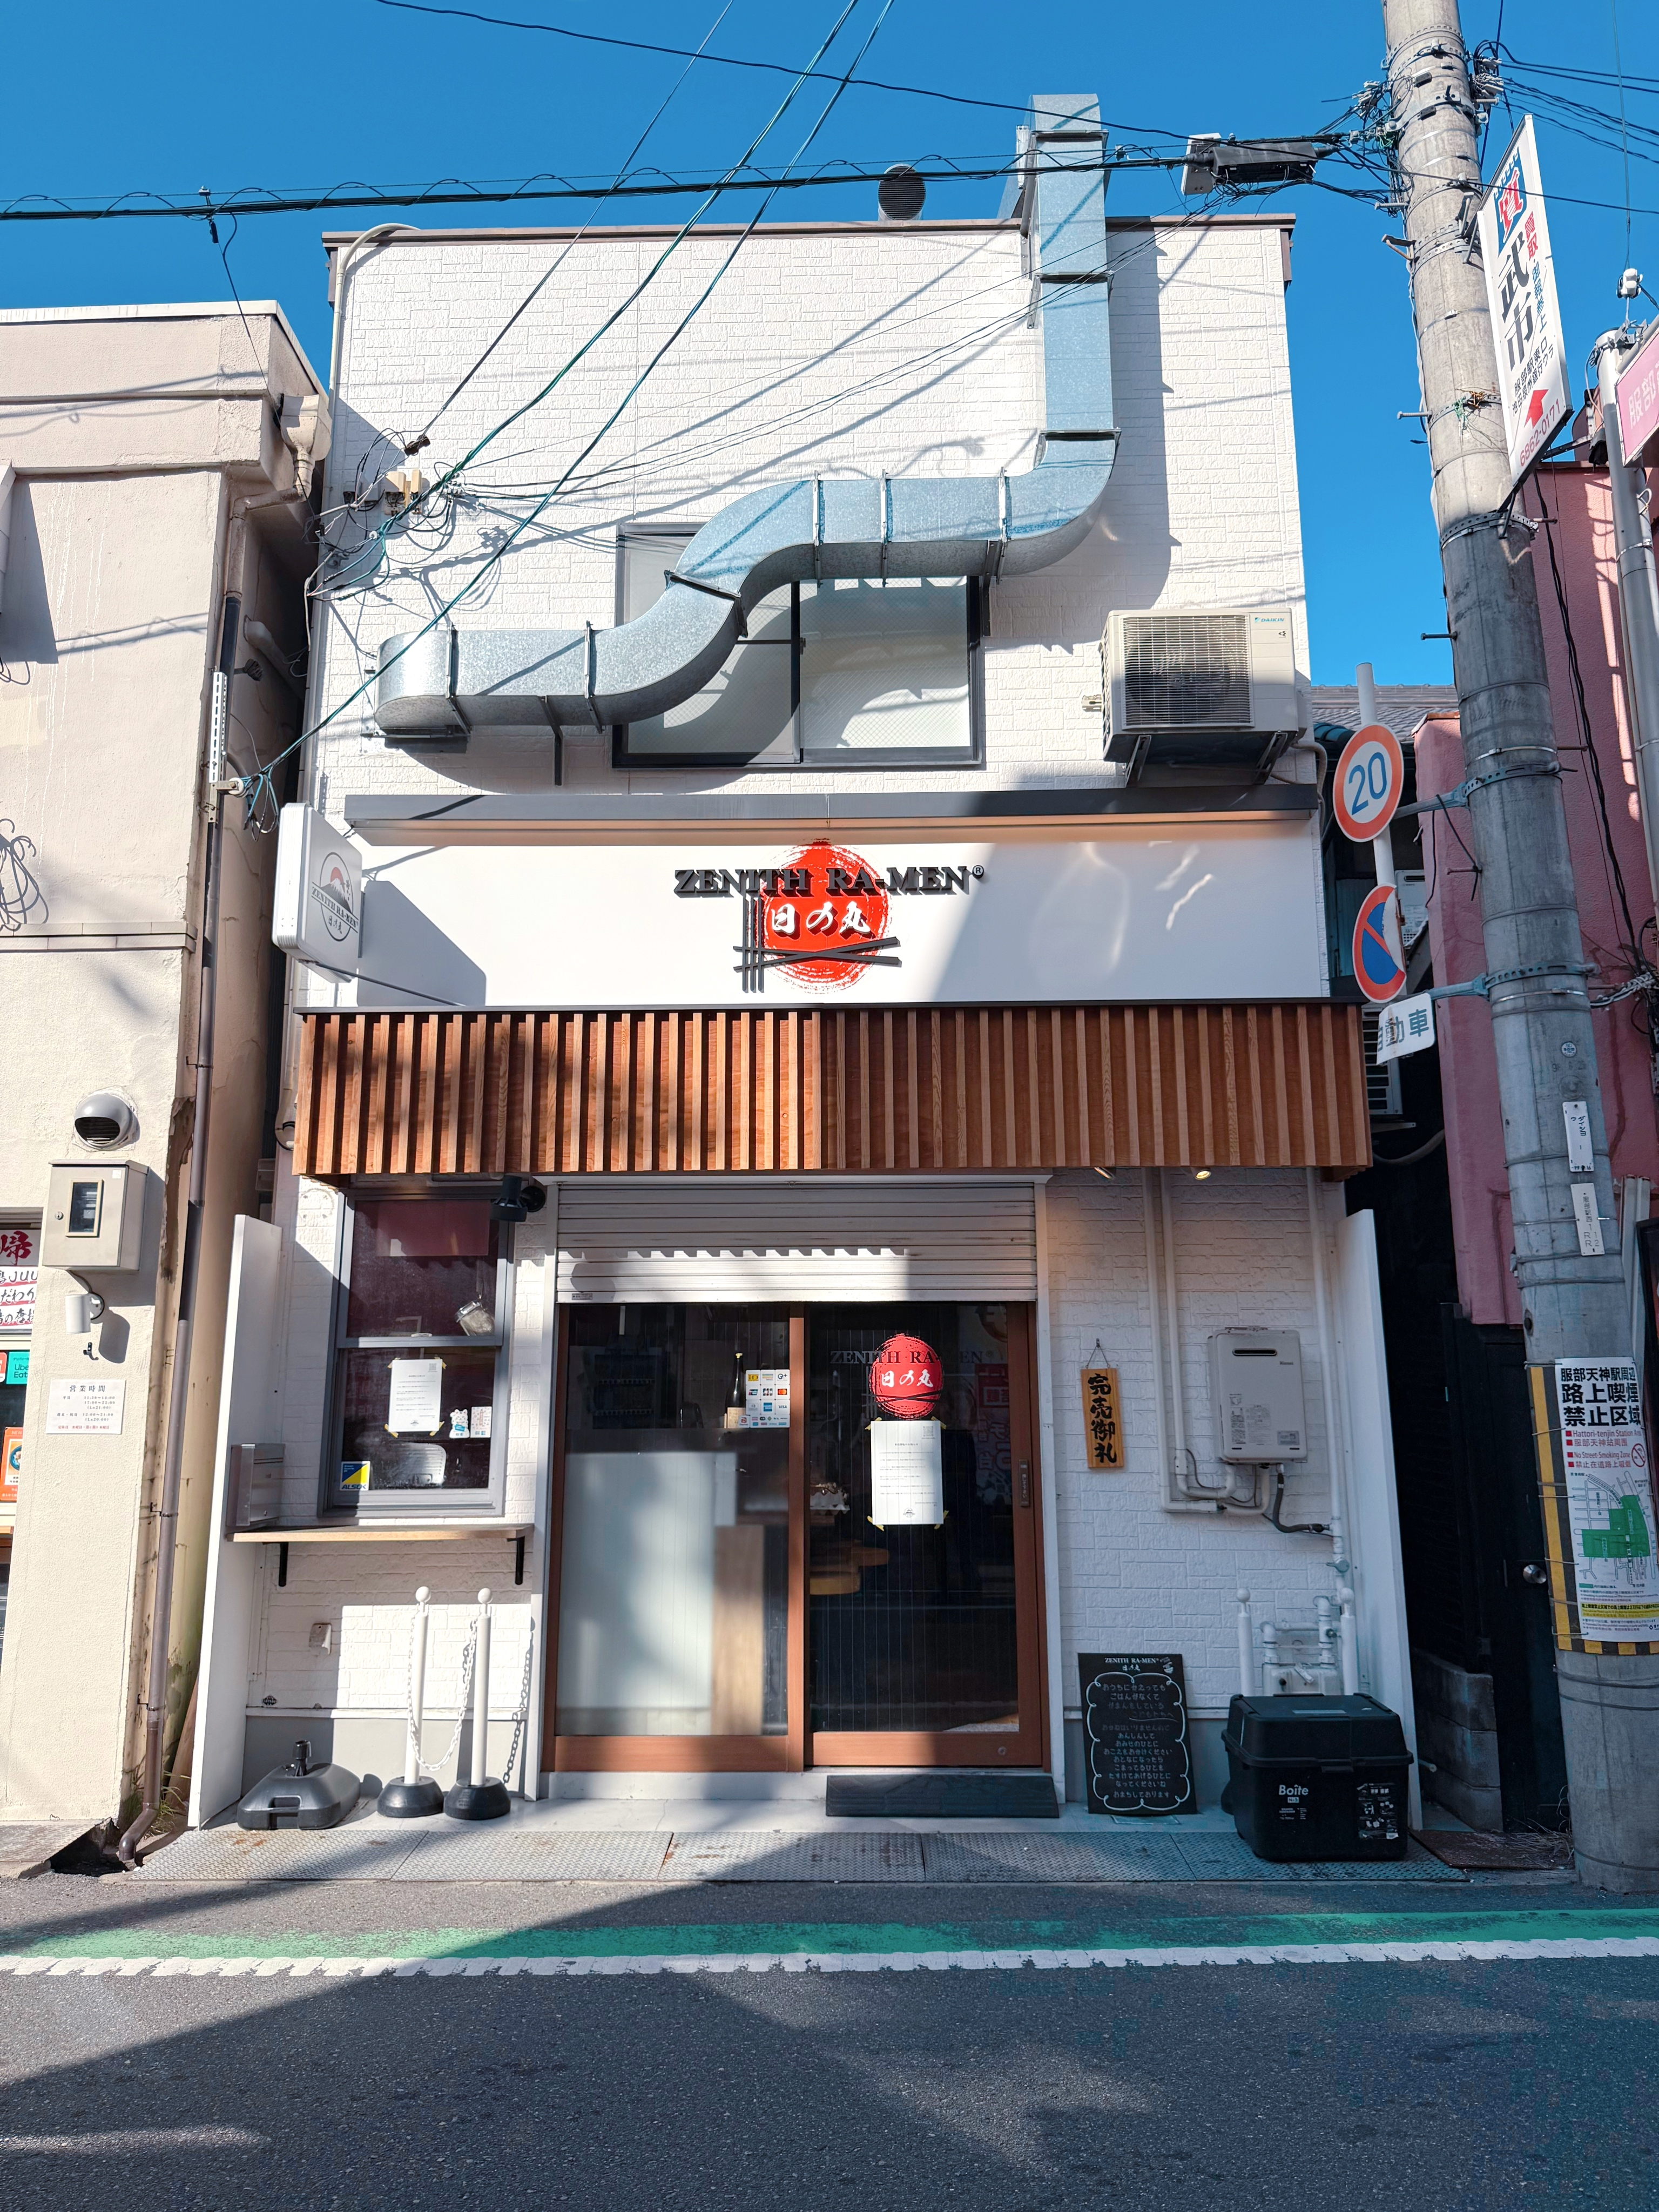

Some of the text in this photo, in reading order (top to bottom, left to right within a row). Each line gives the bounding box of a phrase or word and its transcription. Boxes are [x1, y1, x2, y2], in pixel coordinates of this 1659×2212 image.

[1498, 167, 1523, 243] 質
[1498, 231, 1534, 372] 武市
[1513, 343, 1554, 417] 池田泉州銀行ウラ
[1514, 336, 1547, 397] 服部駅東口
[1628, 360, 1659, 430] 服部
[1520, 399, 1560, 466] 6862-0171
[1348, 752, 1387, 816] 20
[674, 868, 813, 896] ZENITH
[312, 887, 335, 912] ZENITH
[771, 901, 872, 936] 日の丸
[830, 1351, 900, 1364] ZENITH
[881, 1369, 933, 1387] 日の丸
[1561, 1367, 1636, 1382] 服部天神駅周辺
[1562, 1382, 1639, 1404] 路上喫煙
[1088, 1373, 1117, 1463] 完売御礼
[1563, 1405, 1641, 1426] 禁止区域
[1573, 1430, 1615, 1439] Hattori-tenjin
[1582, 1452, 1620, 1460] Street-Smoking
[1278, 1784, 1309, 1796] Boîte
